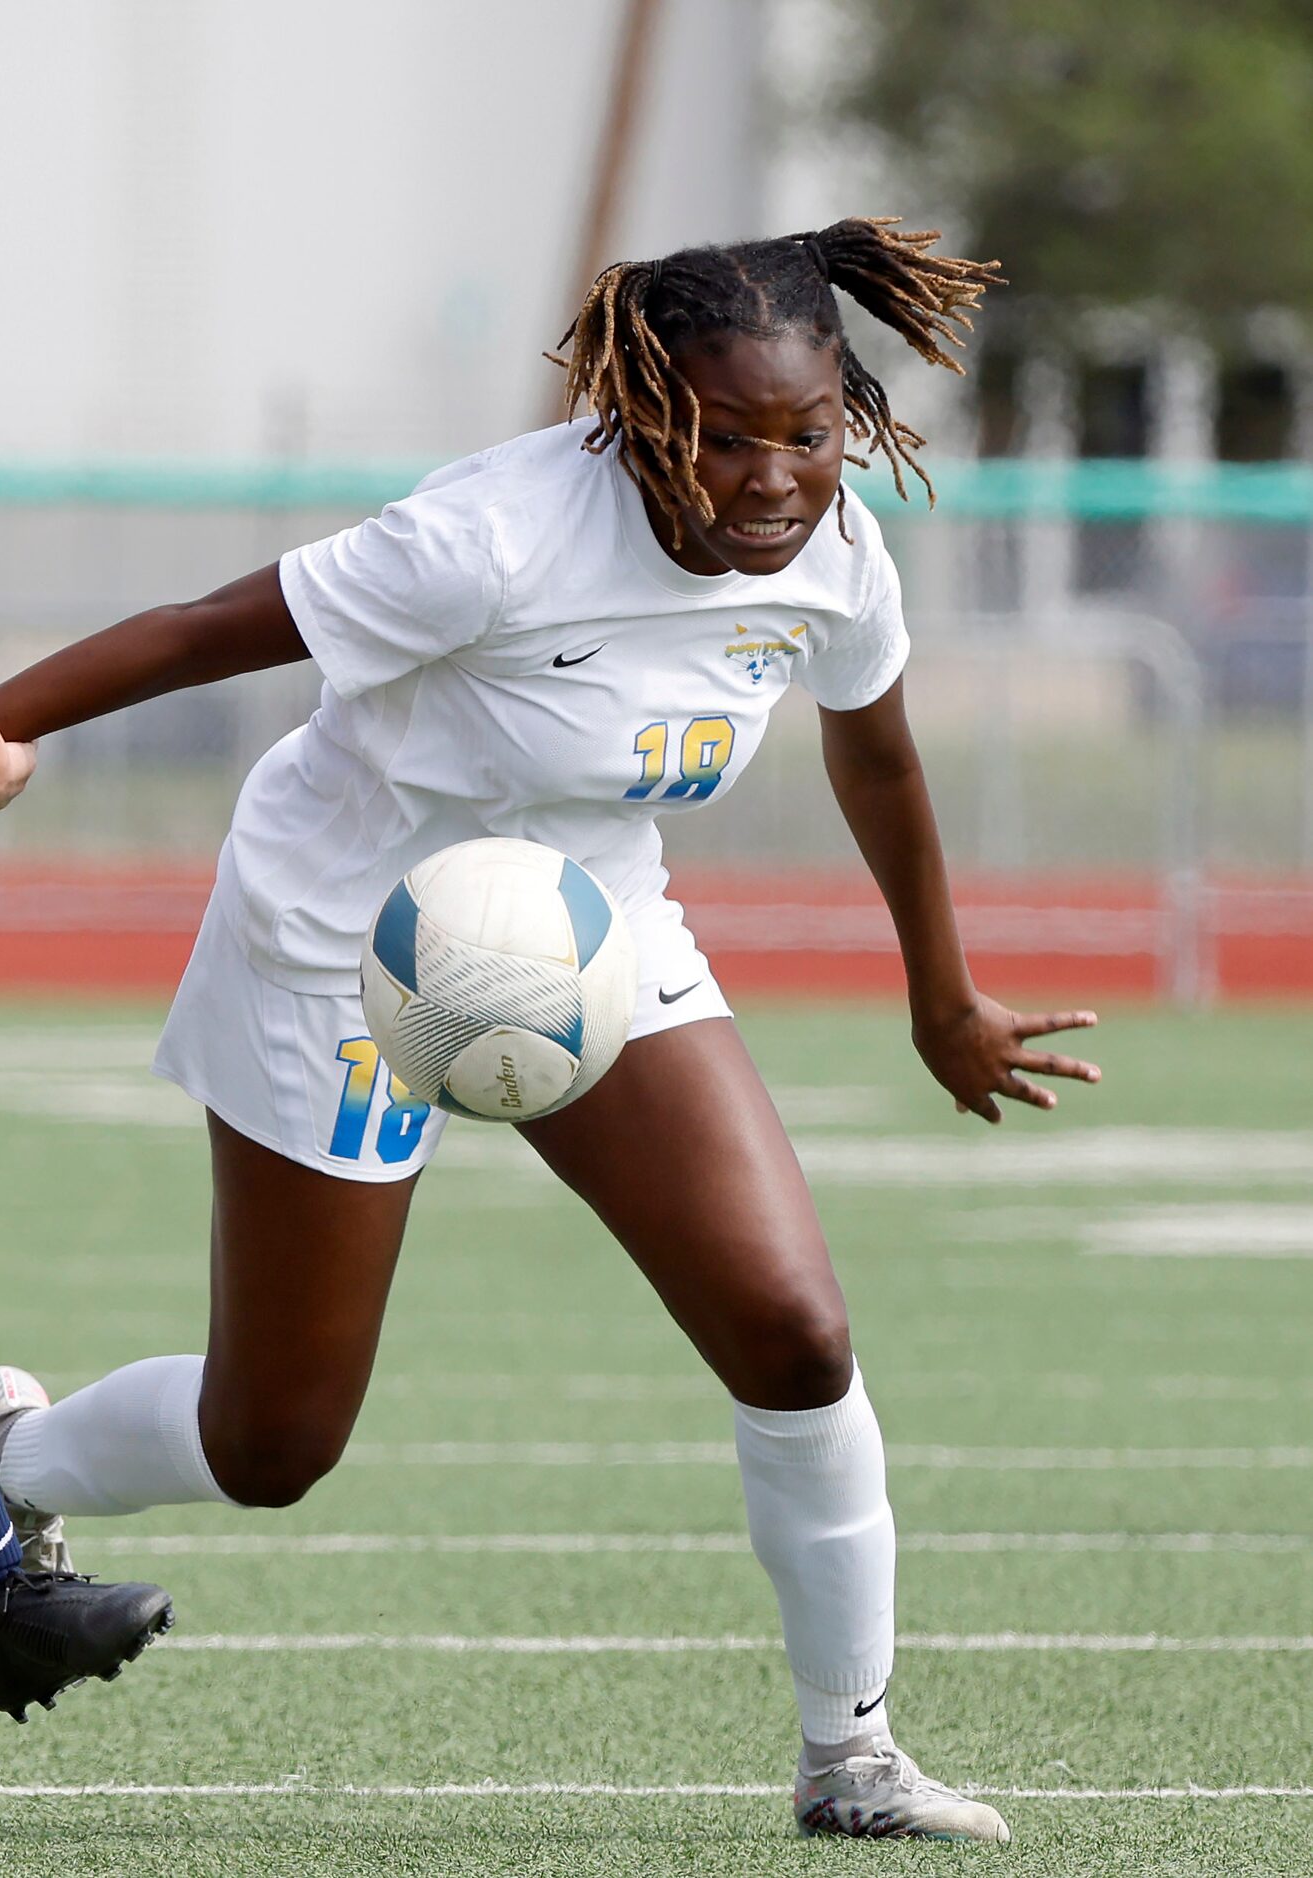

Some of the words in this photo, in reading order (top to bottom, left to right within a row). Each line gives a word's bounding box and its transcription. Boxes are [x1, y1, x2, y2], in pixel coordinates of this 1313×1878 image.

[622, 714, 736, 802] 18
[329, 1035, 431, 1164] 18
[496, 1055, 523, 1108] Baden
